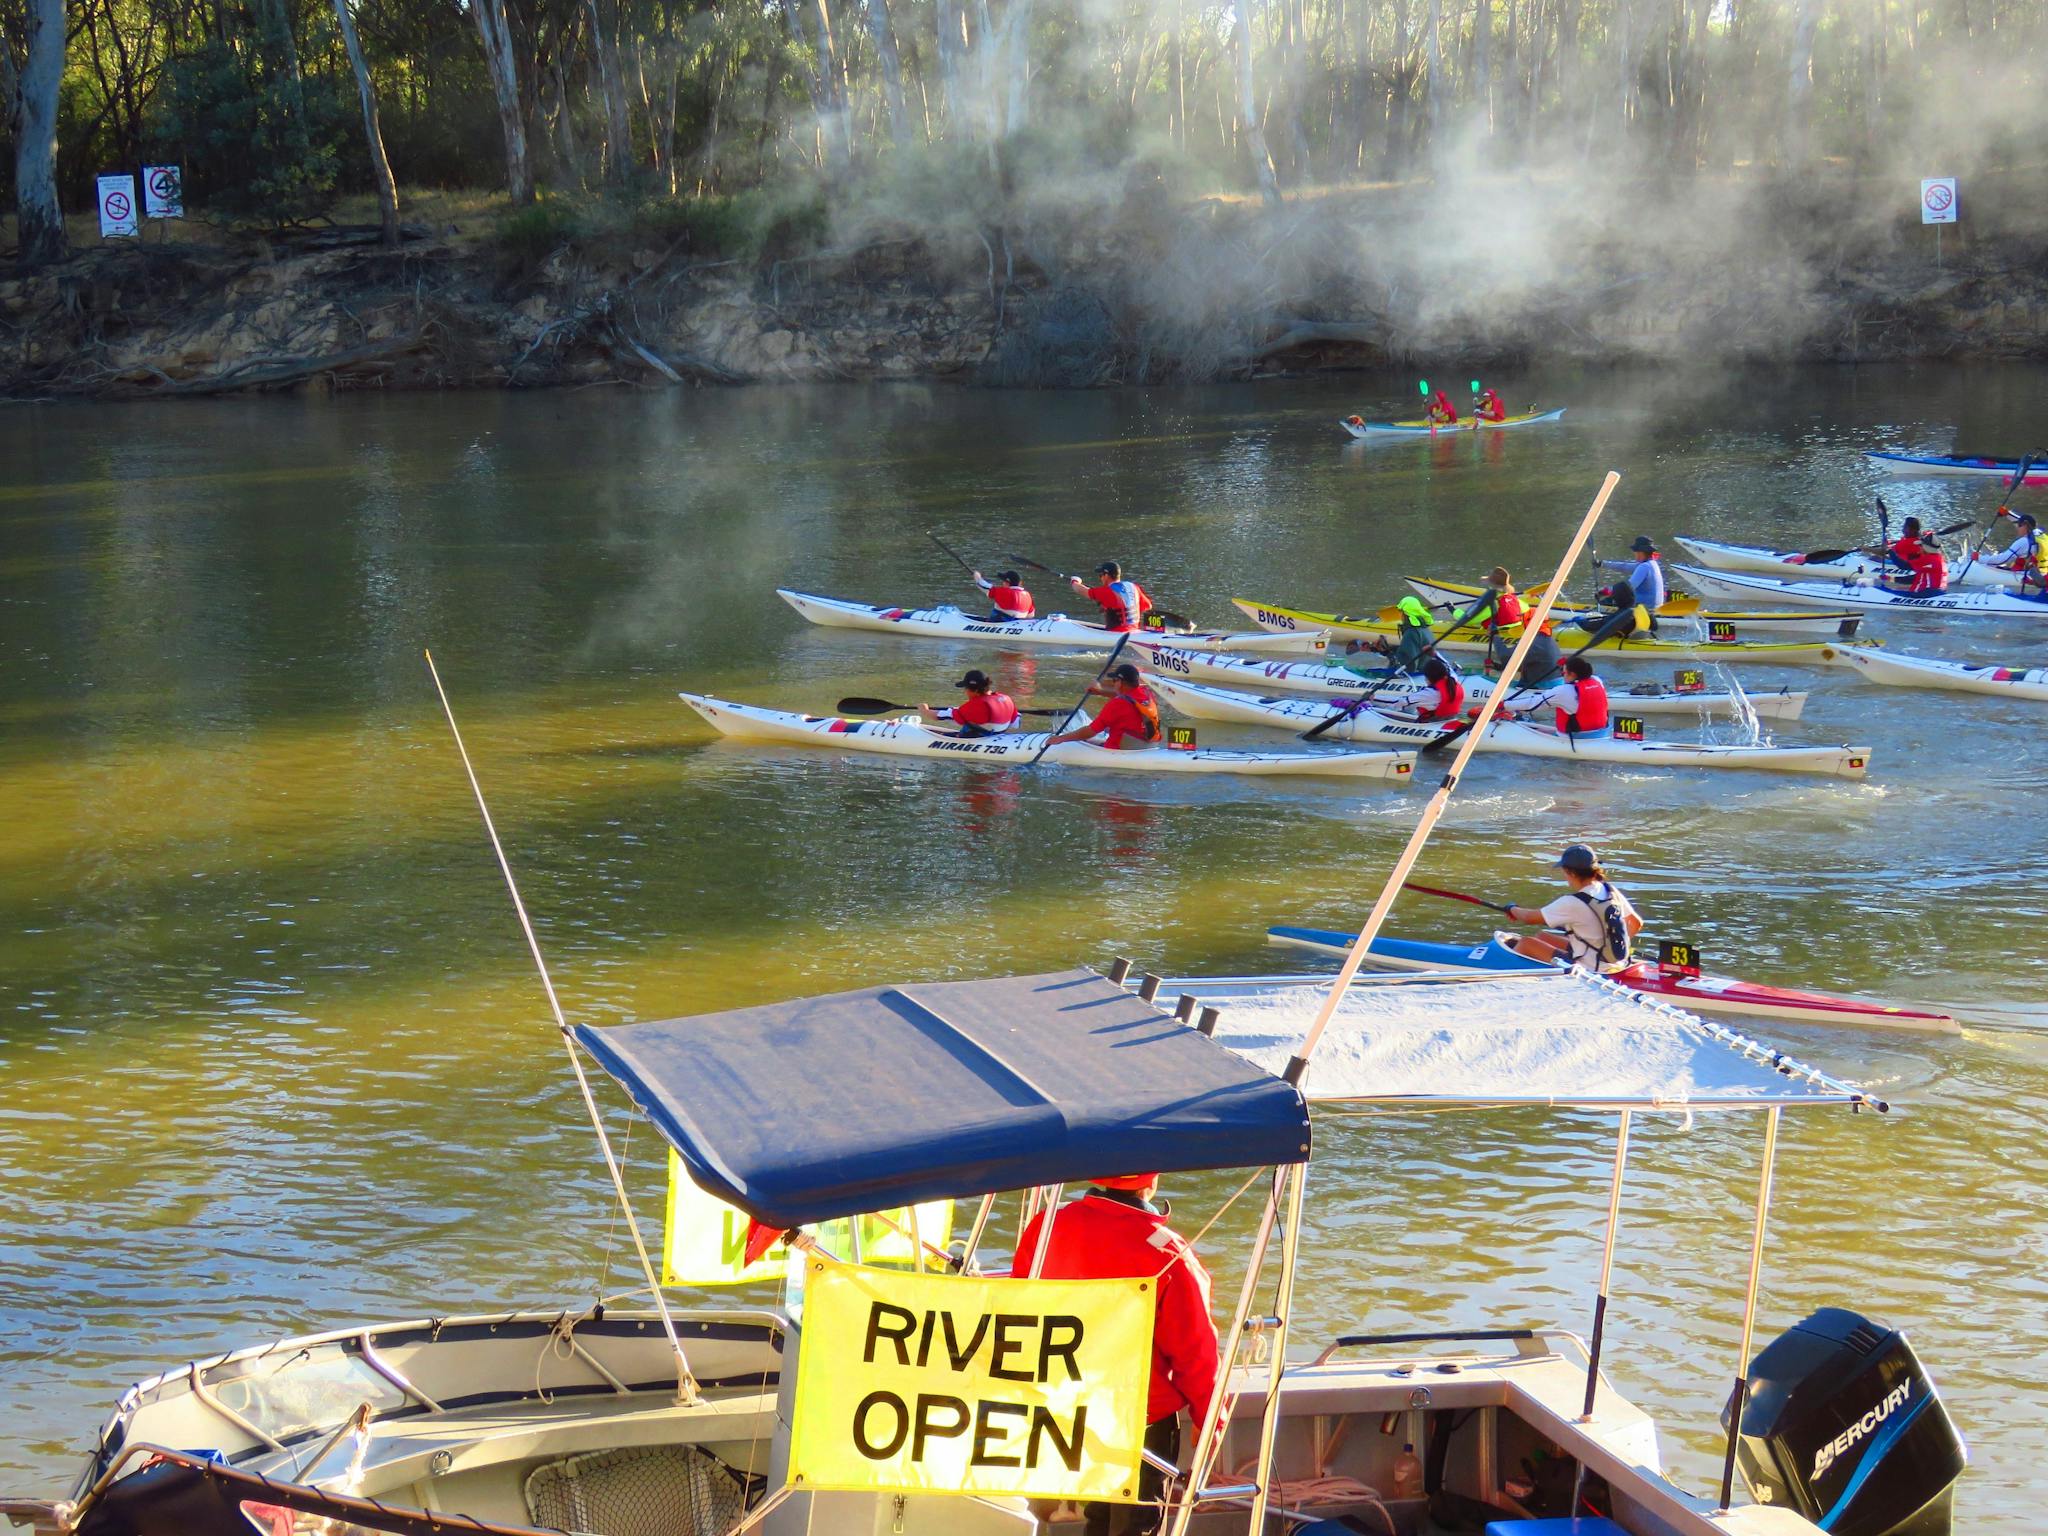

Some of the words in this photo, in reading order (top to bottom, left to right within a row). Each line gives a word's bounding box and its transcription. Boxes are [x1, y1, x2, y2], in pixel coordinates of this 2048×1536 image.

[1889, 598, 1934, 607] MIRAGE
[1148, 616, 1162, 627] 106
[1258, 609, 1295, 630] BMGS
[963, 625, 1002, 634] MIRAGE
[1714, 624, 1730, 635] 111
[1152, 651, 1190, 674] BMGS
[1327, 678, 1356, 688] GREGG
[1684, 671, 1695, 685] 25
[1380, 725, 1433, 738] MIRAGE
[1620, 719, 1638, 734] 110
[1174, 730, 1190, 743] 107
[928, 741, 982, 752] MIRAGE
[983, 745, 1008, 754] 730
[1671, 946, 1688, 966] 53
[863, 1301, 1084, 1383] RIVER
[853, 1390, 1088, 1472] OPEN
[1809, 1376, 1910, 1481] MERCURY
